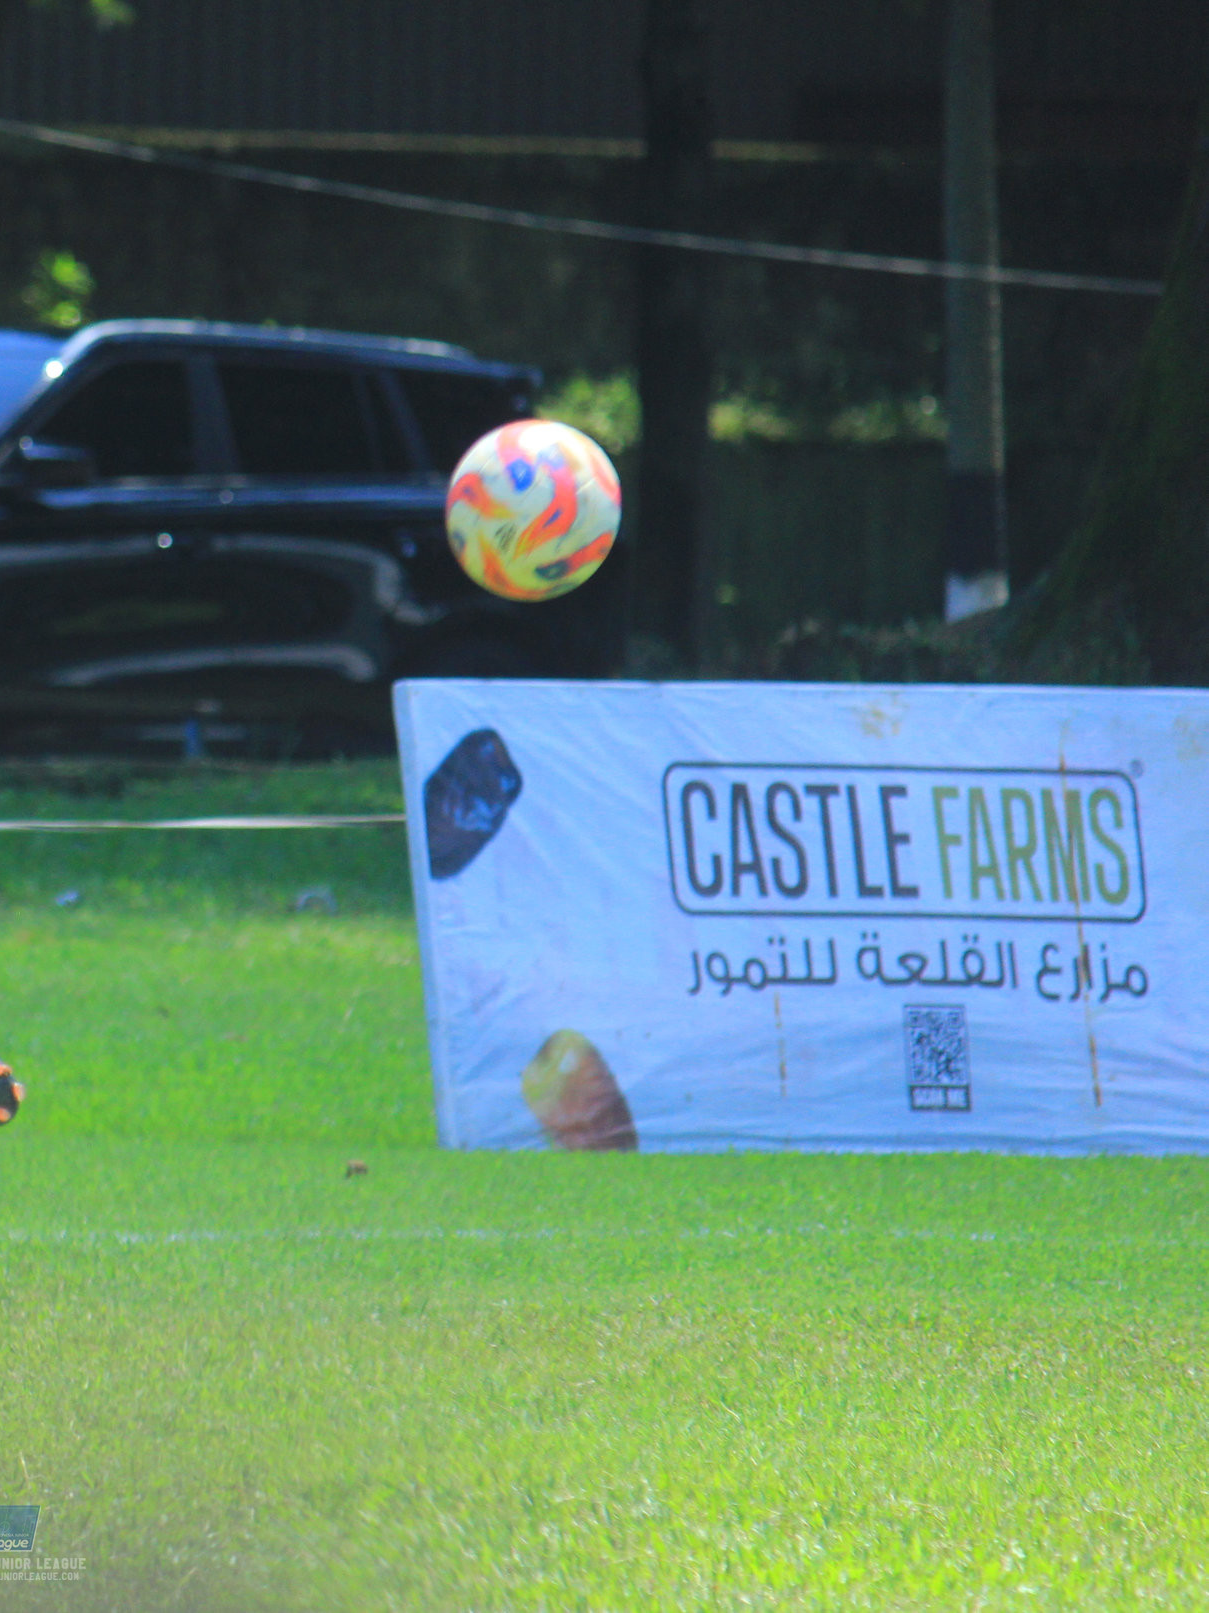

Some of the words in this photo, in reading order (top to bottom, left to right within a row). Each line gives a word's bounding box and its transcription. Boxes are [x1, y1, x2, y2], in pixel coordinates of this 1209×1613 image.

[681, 780, 920, 899] CASTLE
[931, 786, 1130, 905] FARMS
[687, 936, 837, 996] للتمور
[856, 931, 1019, 989] القلعة
[1036, 942, 1149, 1002] مزارع
